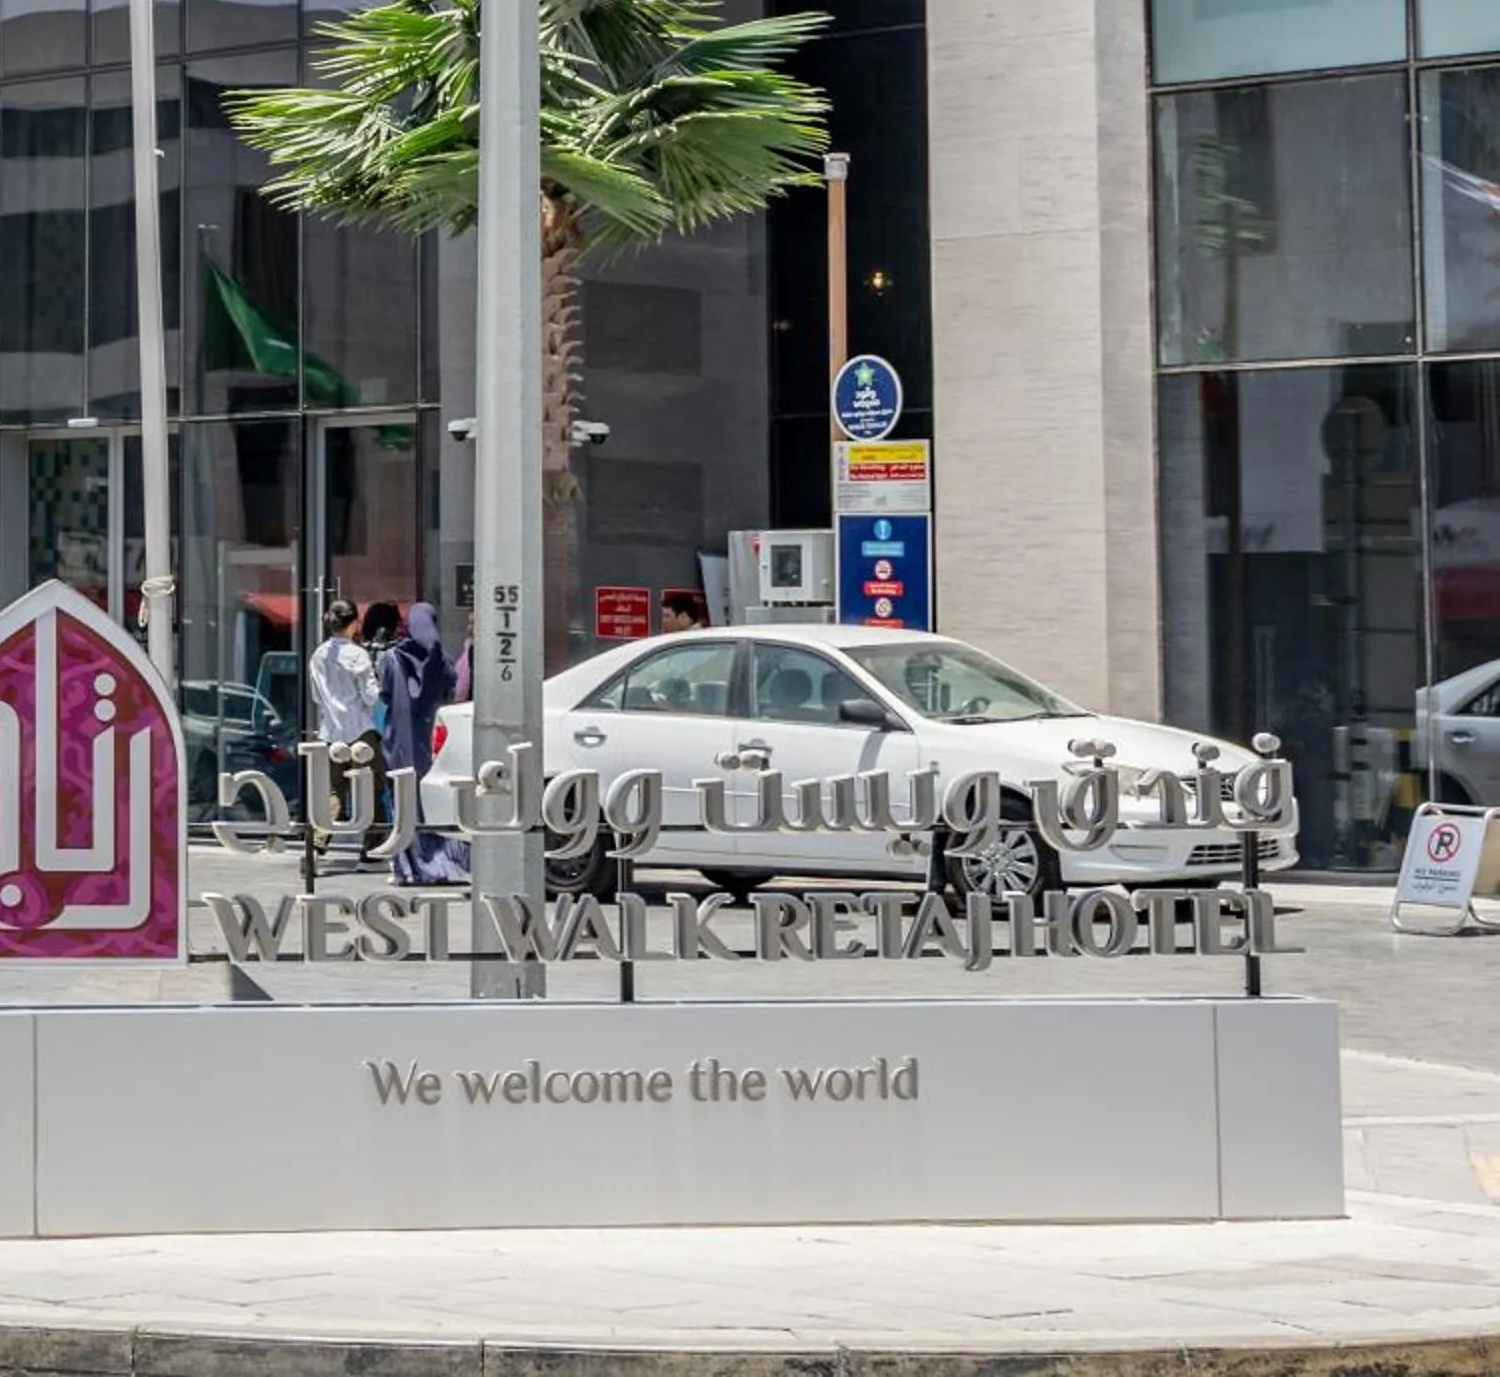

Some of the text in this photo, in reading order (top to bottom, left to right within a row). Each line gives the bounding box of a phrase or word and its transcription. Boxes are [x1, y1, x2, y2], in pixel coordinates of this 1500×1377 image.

[494, 585, 519, 603] 55
[500, 638, 512, 655] 2
[501, 665, 513, 681] 6
[211, 731, 1294, 860] فندق ويست ووك رتاج
[202, 887, 1306, 971] WEST WALK RETAJ HOTEL
[362, 1055, 920, 1106] We welcome the world
